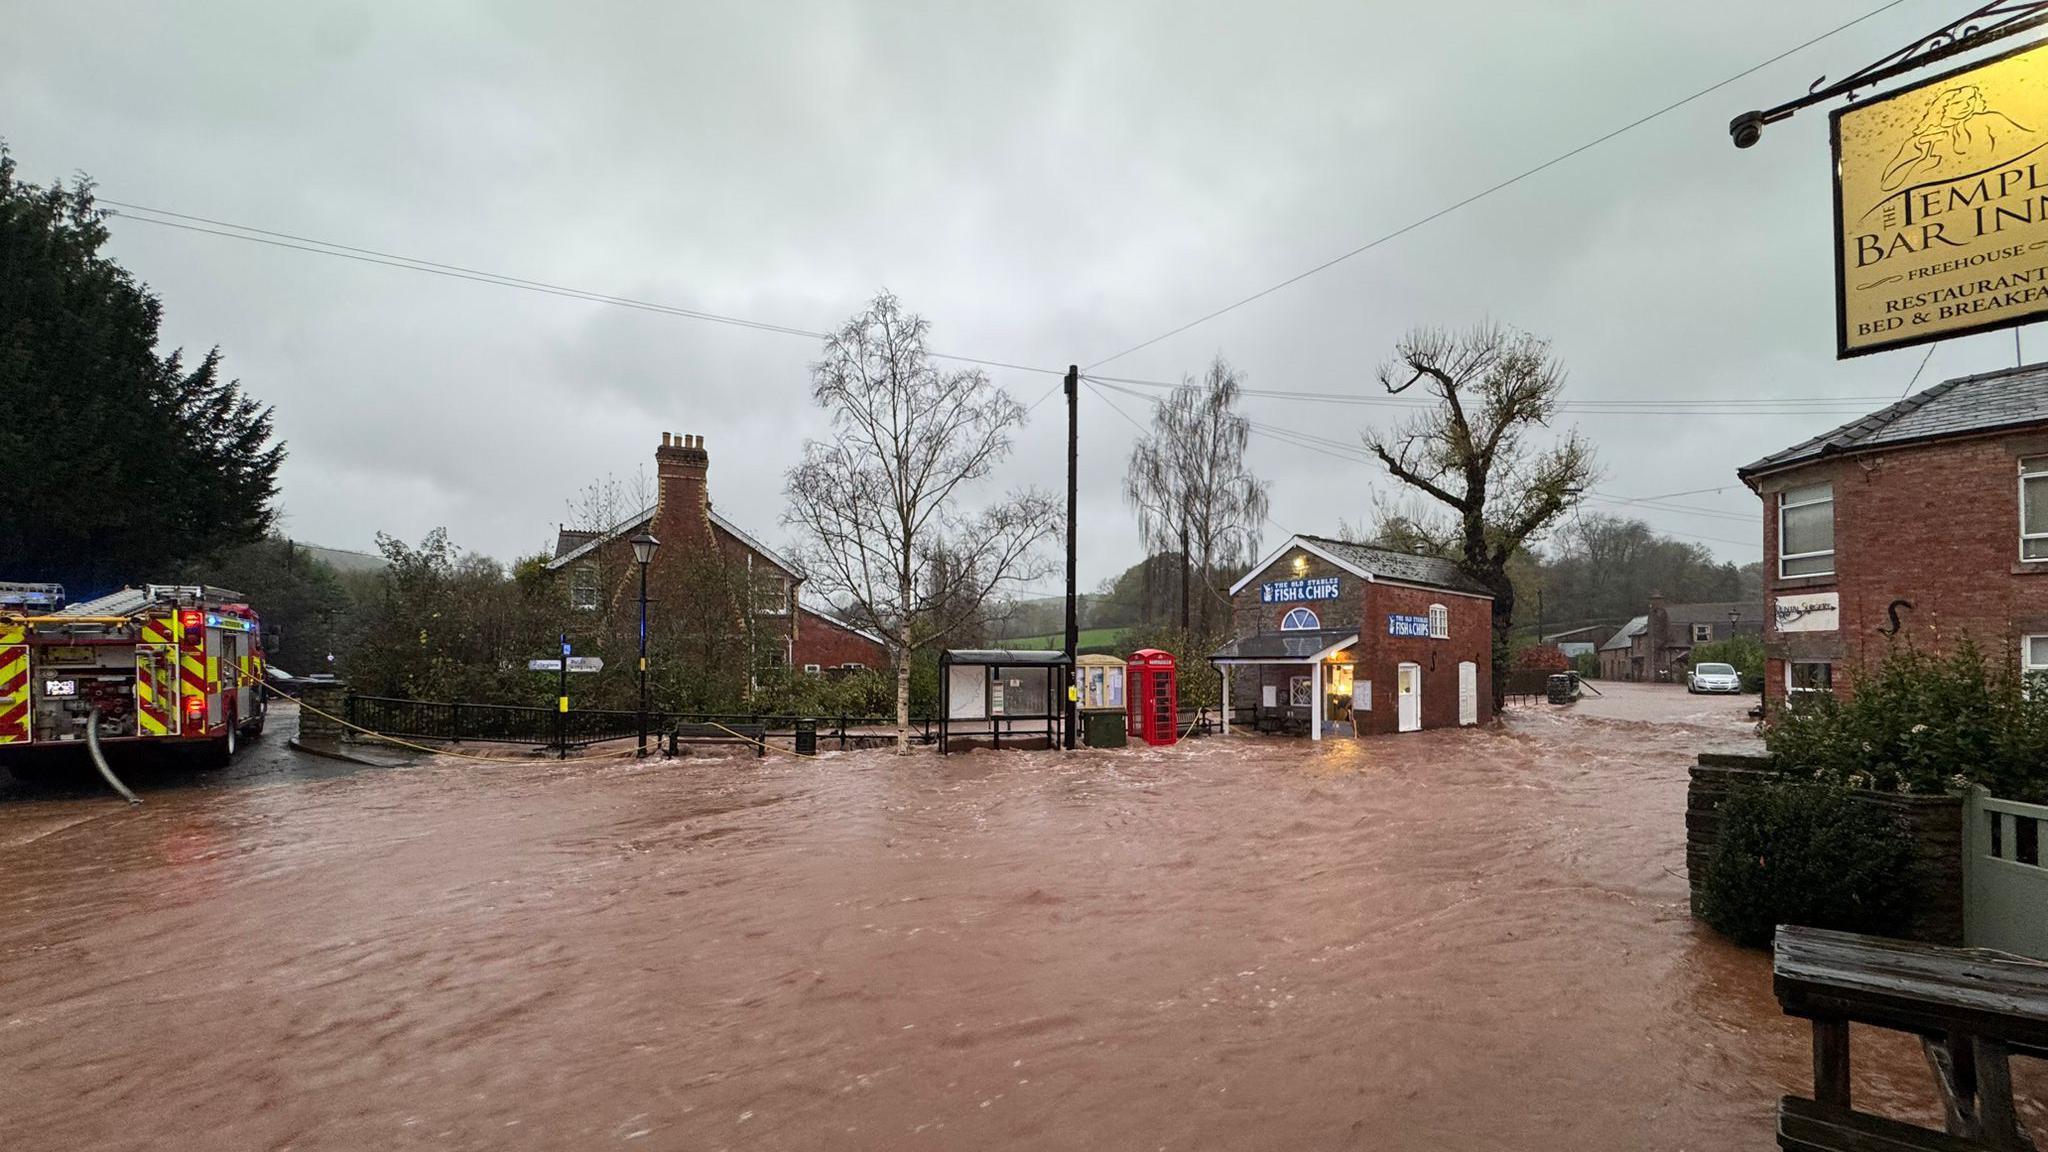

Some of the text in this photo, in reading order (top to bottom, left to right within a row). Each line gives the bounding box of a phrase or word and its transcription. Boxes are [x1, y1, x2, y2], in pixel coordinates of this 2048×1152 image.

[1883, 203, 1897, 231] THE
[1855, 222, 1970, 268] BAR
[1908, 245, 2026, 281] FREEHOUSE
[1886, 266, 2048, 314] RESTAURANT
[1858, 316, 1904, 336] BED
[1912, 312, 1931, 325] &
[1274, 585, 1339, 602] FISH & CHIPS
[1291, 580, 1304, 588] OLD
[1307, 577, 1339, 586] STABLES
[1395, 621, 1409, 636] FISH
[1412, 623, 1429, 636] CHIPS
